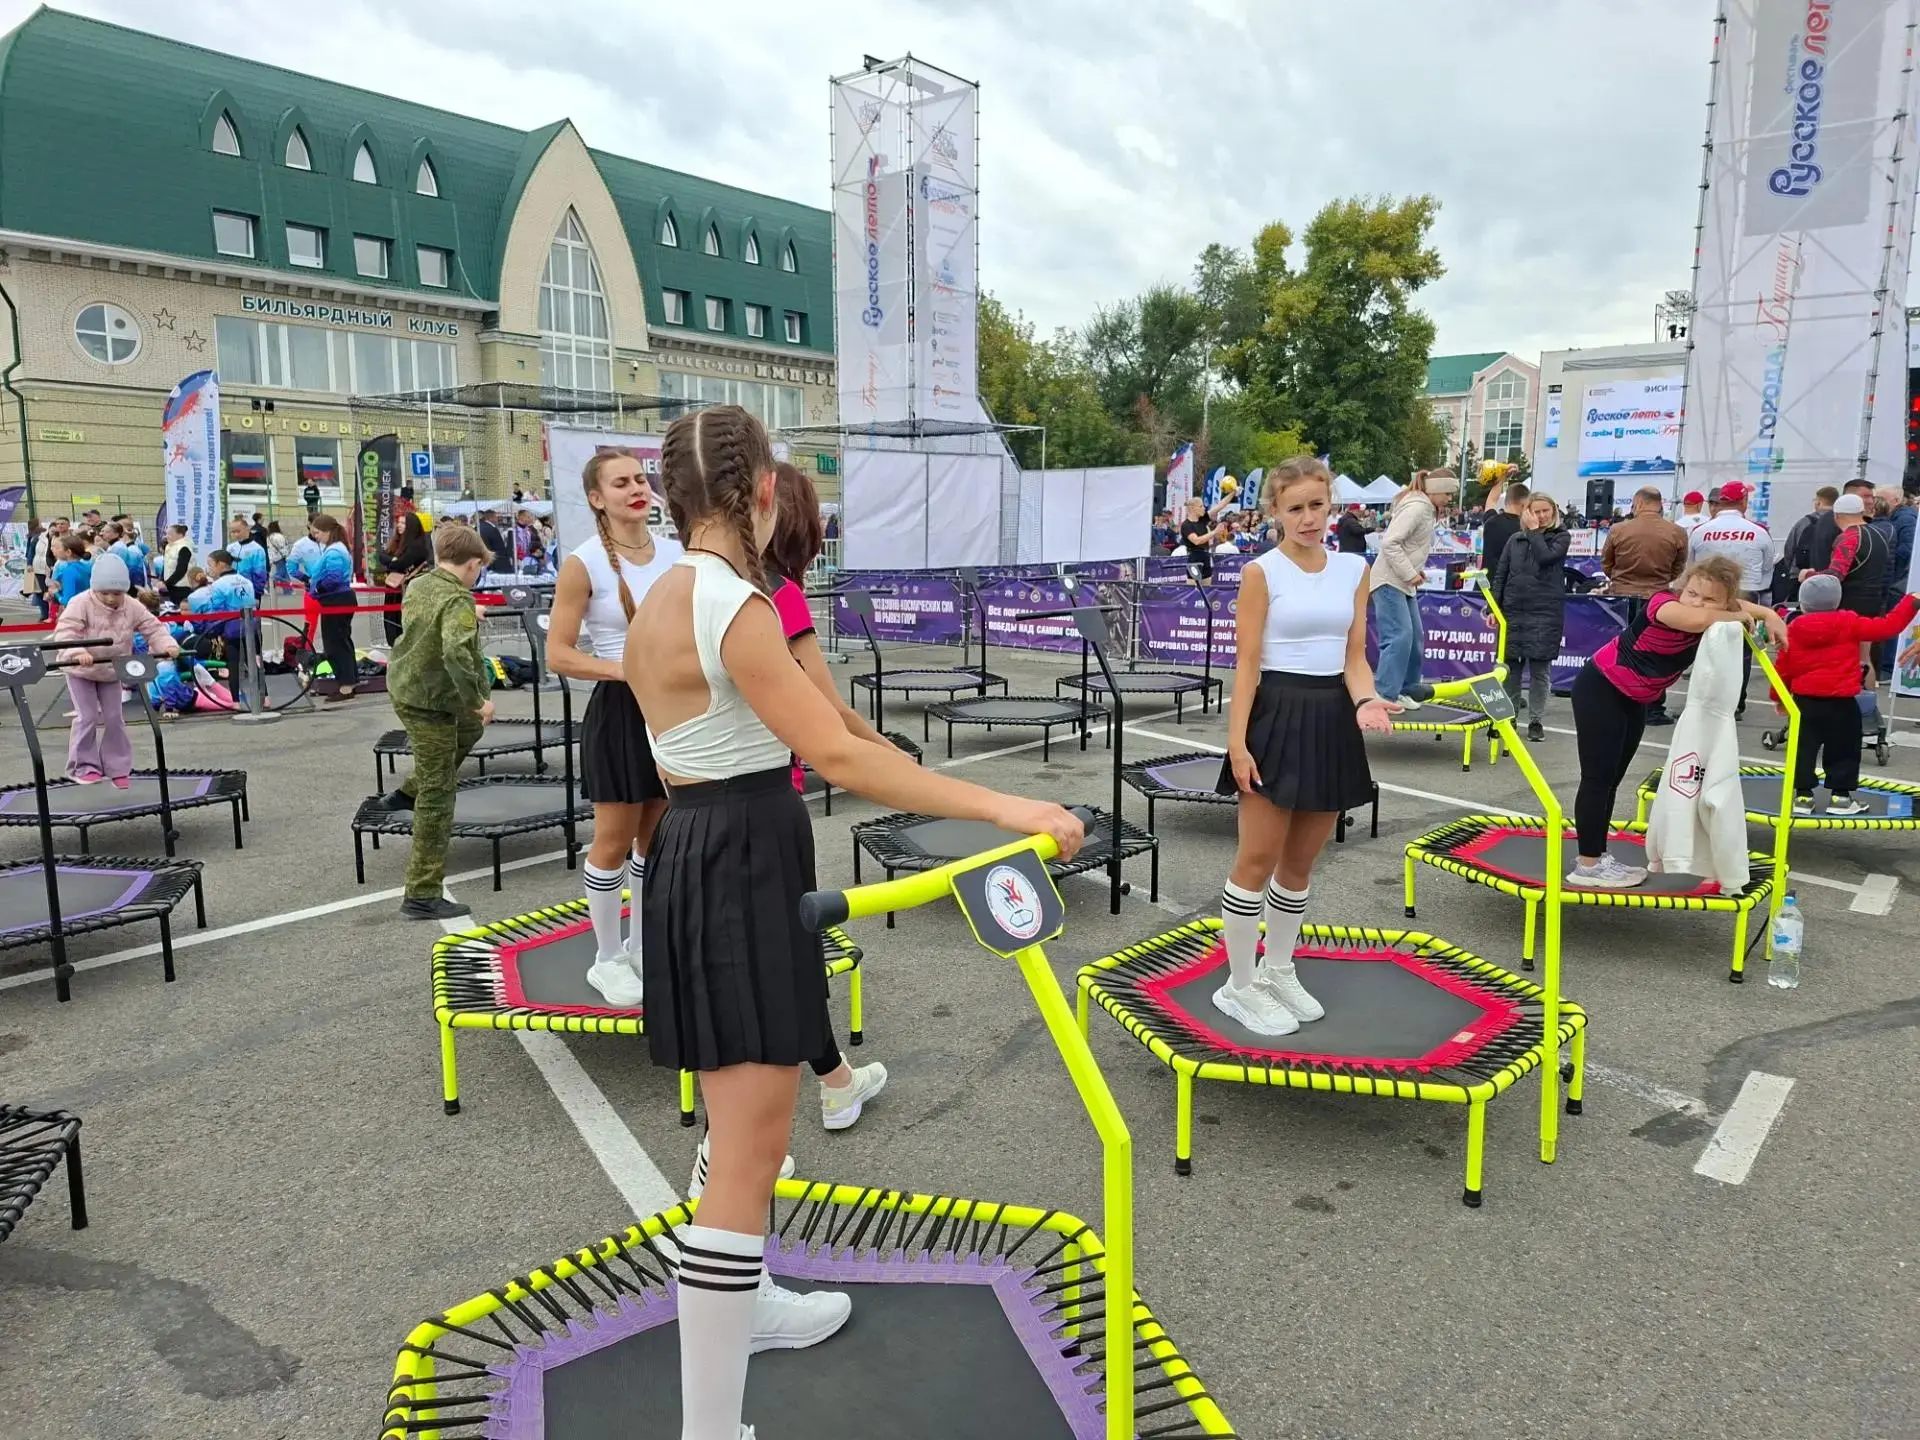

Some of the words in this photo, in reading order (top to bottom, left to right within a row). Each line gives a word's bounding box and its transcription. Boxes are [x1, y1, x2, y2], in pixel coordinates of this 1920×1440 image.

[1769, 59, 1823, 196] Русское
[1804, 0, 1831, 54] ле
[867, 183, 878, 241] лето
[862, 243, 883, 328] Русское
[241, 295, 393, 328] БИЛЬЯРДНЫЙ
[408, 317, 459, 337] КЛУБ
[1587, 408, 1630, 424] Русское
[1630, 410, 1661, 420] лето
[222, 415, 373, 435] ТОРГОВЫЙ
[206, 474, 215, 491] без
[382, 470, 391, 506] КОШЕК
[1703, 531, 1755, 542] RUSSIA
[989, 622, 1017, 633] ПОБЕДЫ
[1018, 624, 1034, 635] НАД
[1036, 625, 1063, 636] САМИМ
[1177, 630, 1207, 640] ИЗМЕНИТ
[1213, 632, 1232, 641] СВОЙ
[1428, 630, 1476, 644] ТРУДНО,
[1479, 632, 1495, 644] НО
[1149, 641, 1189, 651] СТАРТОВАТЬ
[1190, 643, 1217, 653] СЕЙЧС
[1425, 648, 1445, 660] ЭТО
[1448, 650, 1486, 663] БУДЕТ
